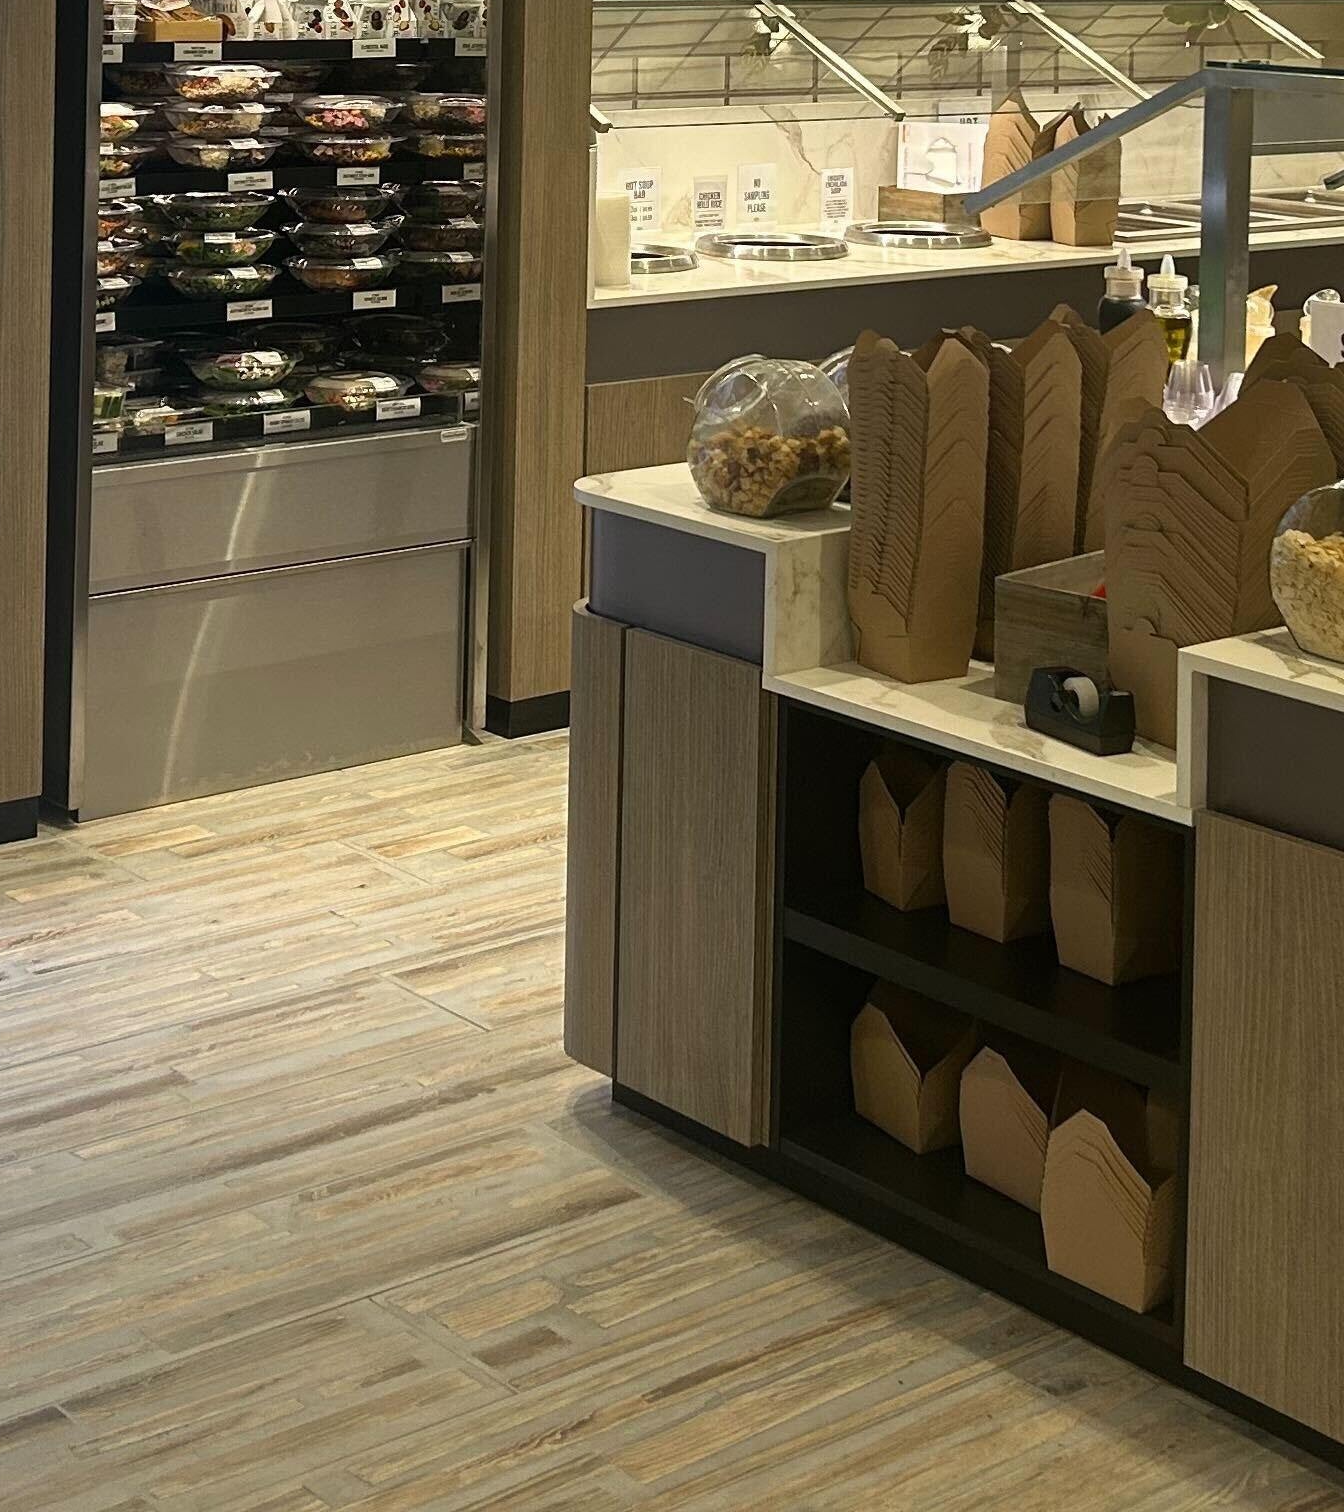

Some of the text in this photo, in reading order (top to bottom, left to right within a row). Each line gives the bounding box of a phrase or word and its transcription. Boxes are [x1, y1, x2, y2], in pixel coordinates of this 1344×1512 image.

[626, 180, 654, 190] HOT SOUP
[754, 178, 761, 188] NO
[634, 190, 646, 199] BAR
[744, 190, 770, 202] SAMPLING
[747, 203, 766, 213] PLEASE
